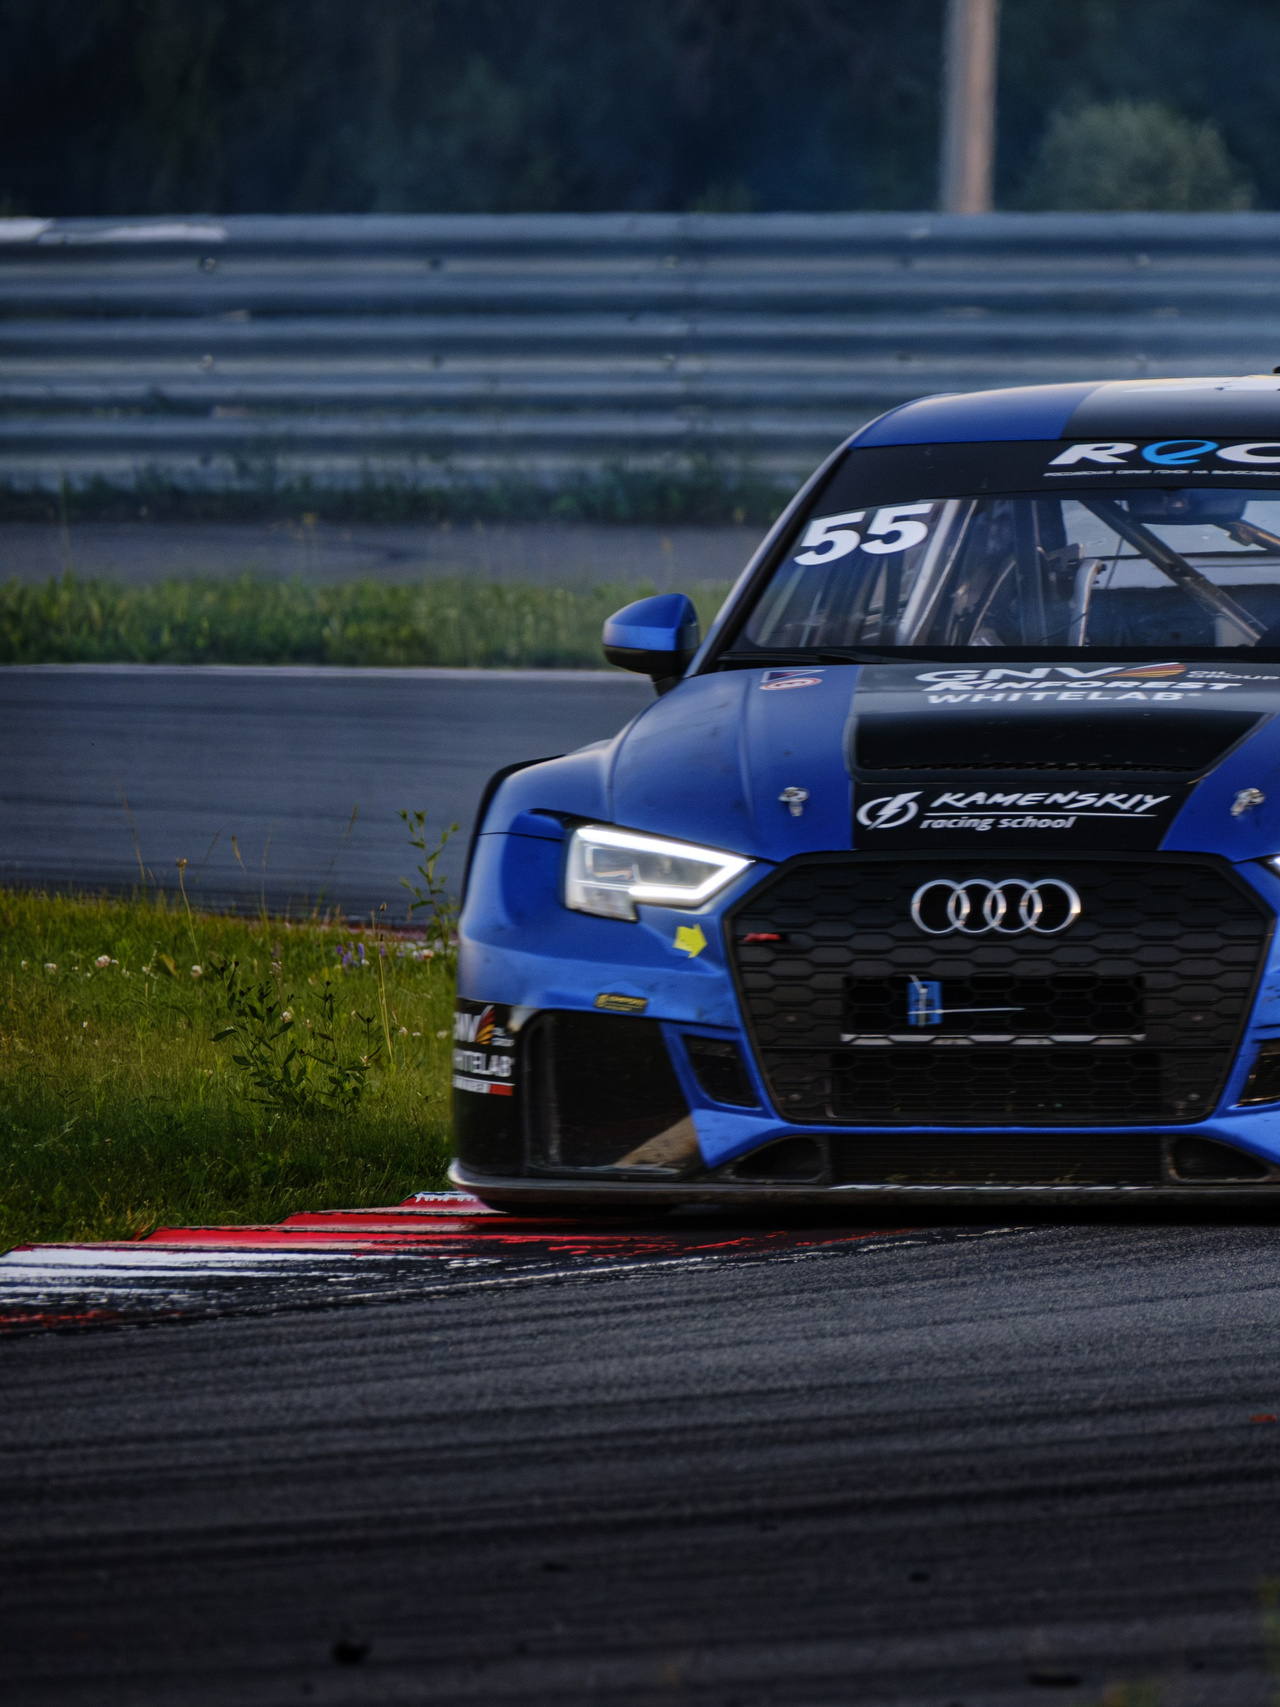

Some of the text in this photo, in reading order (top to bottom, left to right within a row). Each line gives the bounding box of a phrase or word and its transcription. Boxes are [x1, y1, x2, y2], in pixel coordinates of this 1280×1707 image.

[793, 502, 934, 566] 55
[915, 667, 1127, 682] GNV
[929, 790, 1172, 813] KAMENSKIY
[919, 815, 1078, 831] racing school
